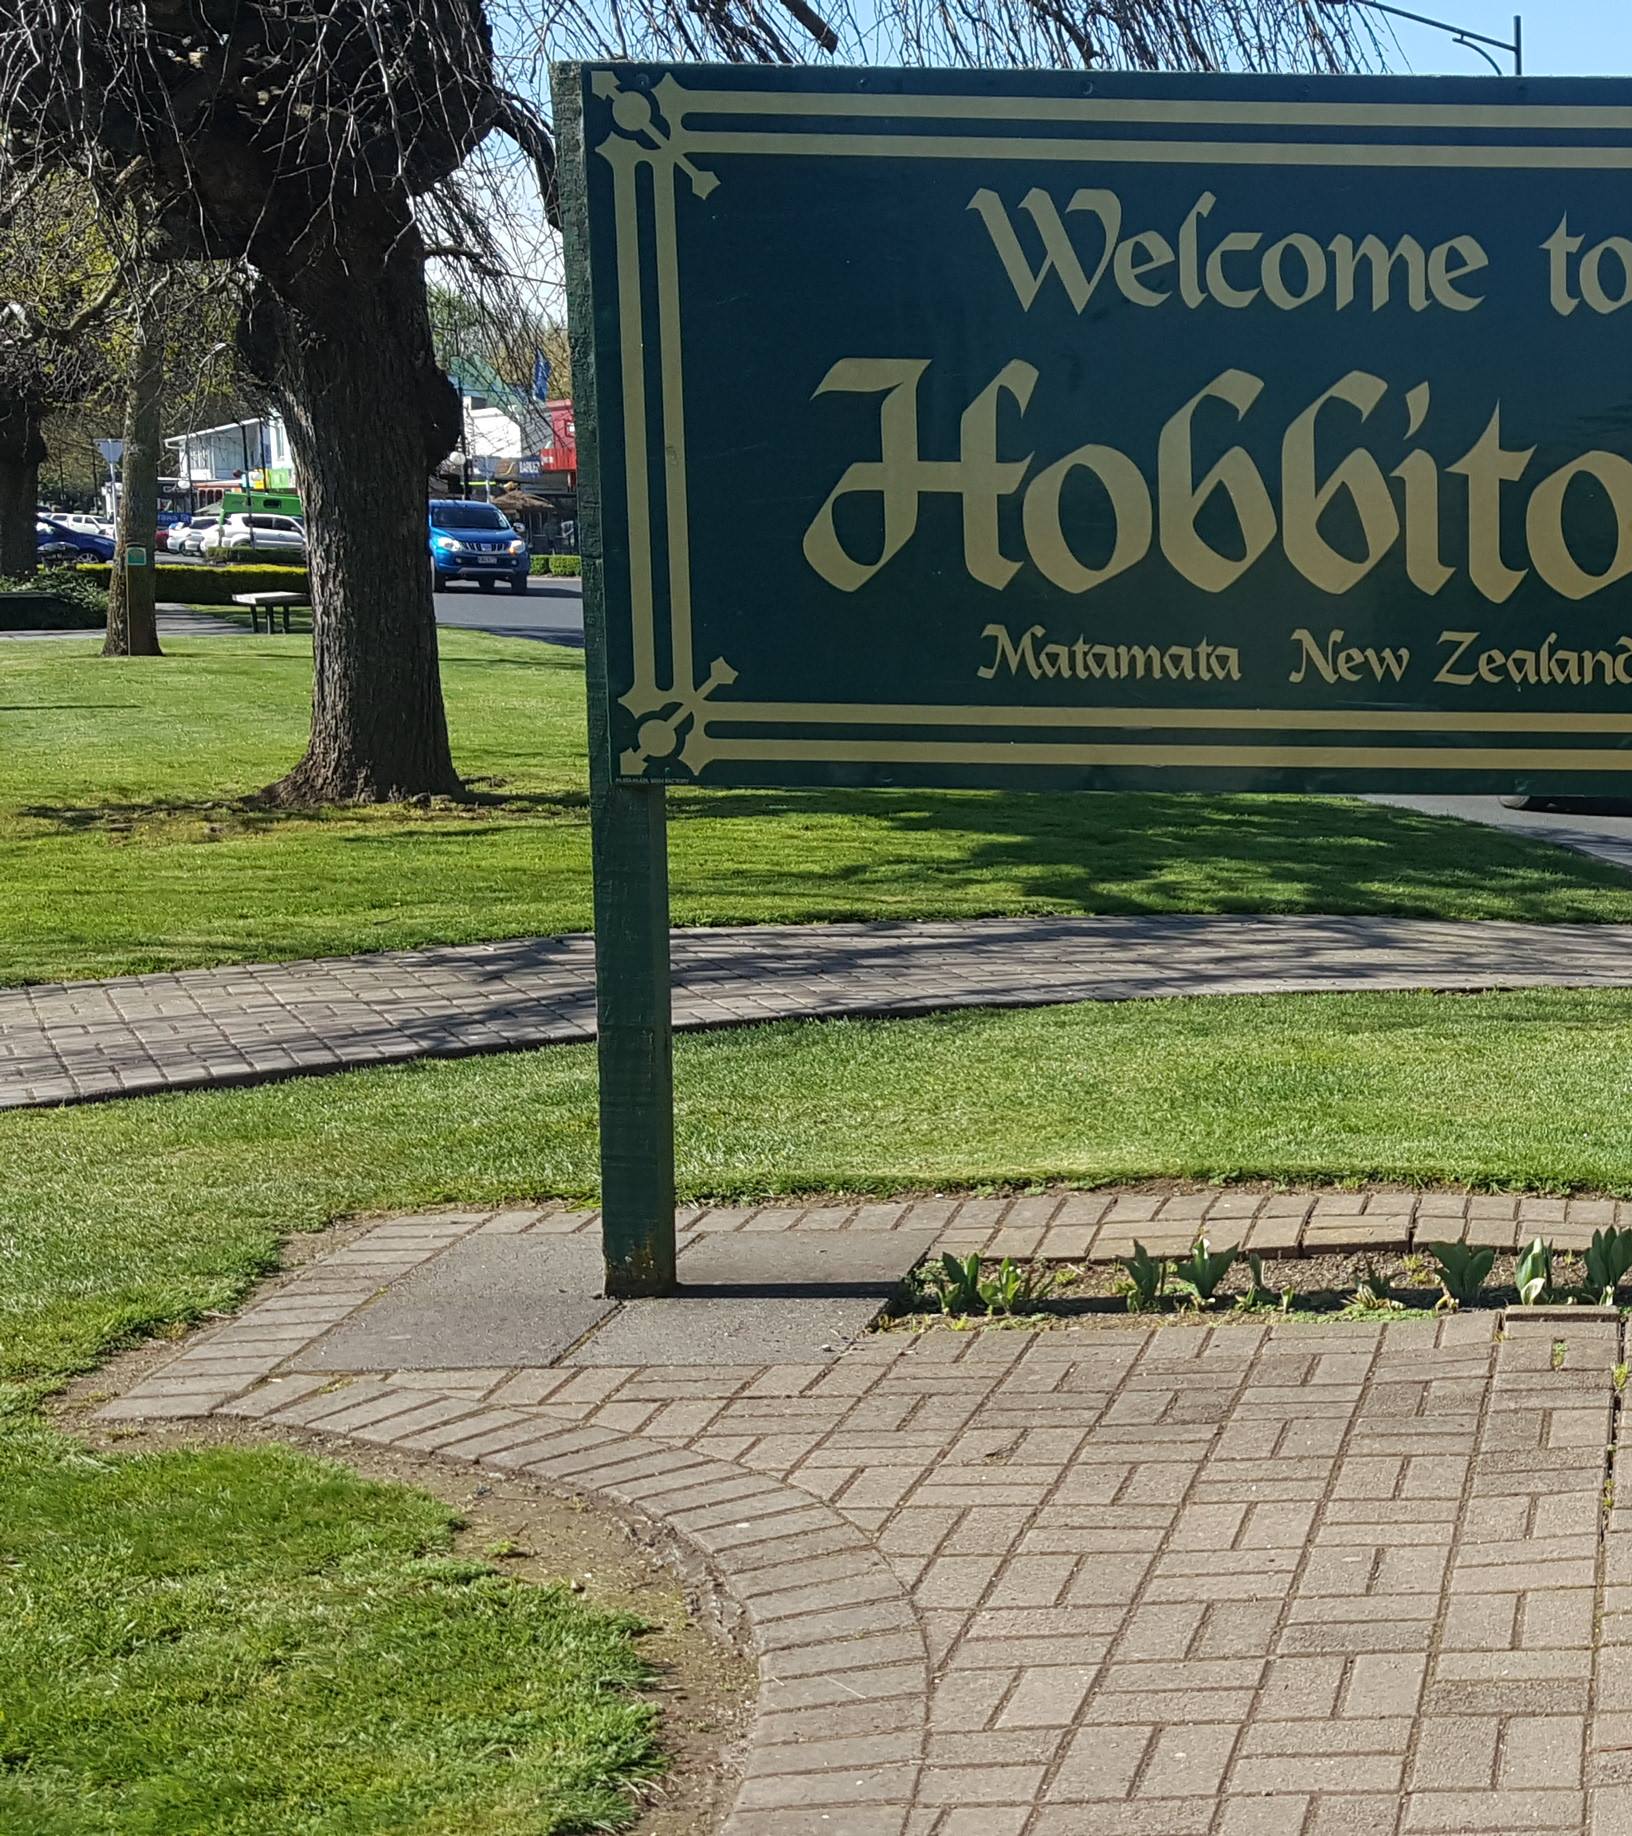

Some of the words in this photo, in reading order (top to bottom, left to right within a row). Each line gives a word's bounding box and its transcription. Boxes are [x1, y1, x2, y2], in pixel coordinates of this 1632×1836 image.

[966, 187, 1489, 315] Welcome
[977, 623, 1242, 684] Matamata
[1288, 628, 1411, 686] New
